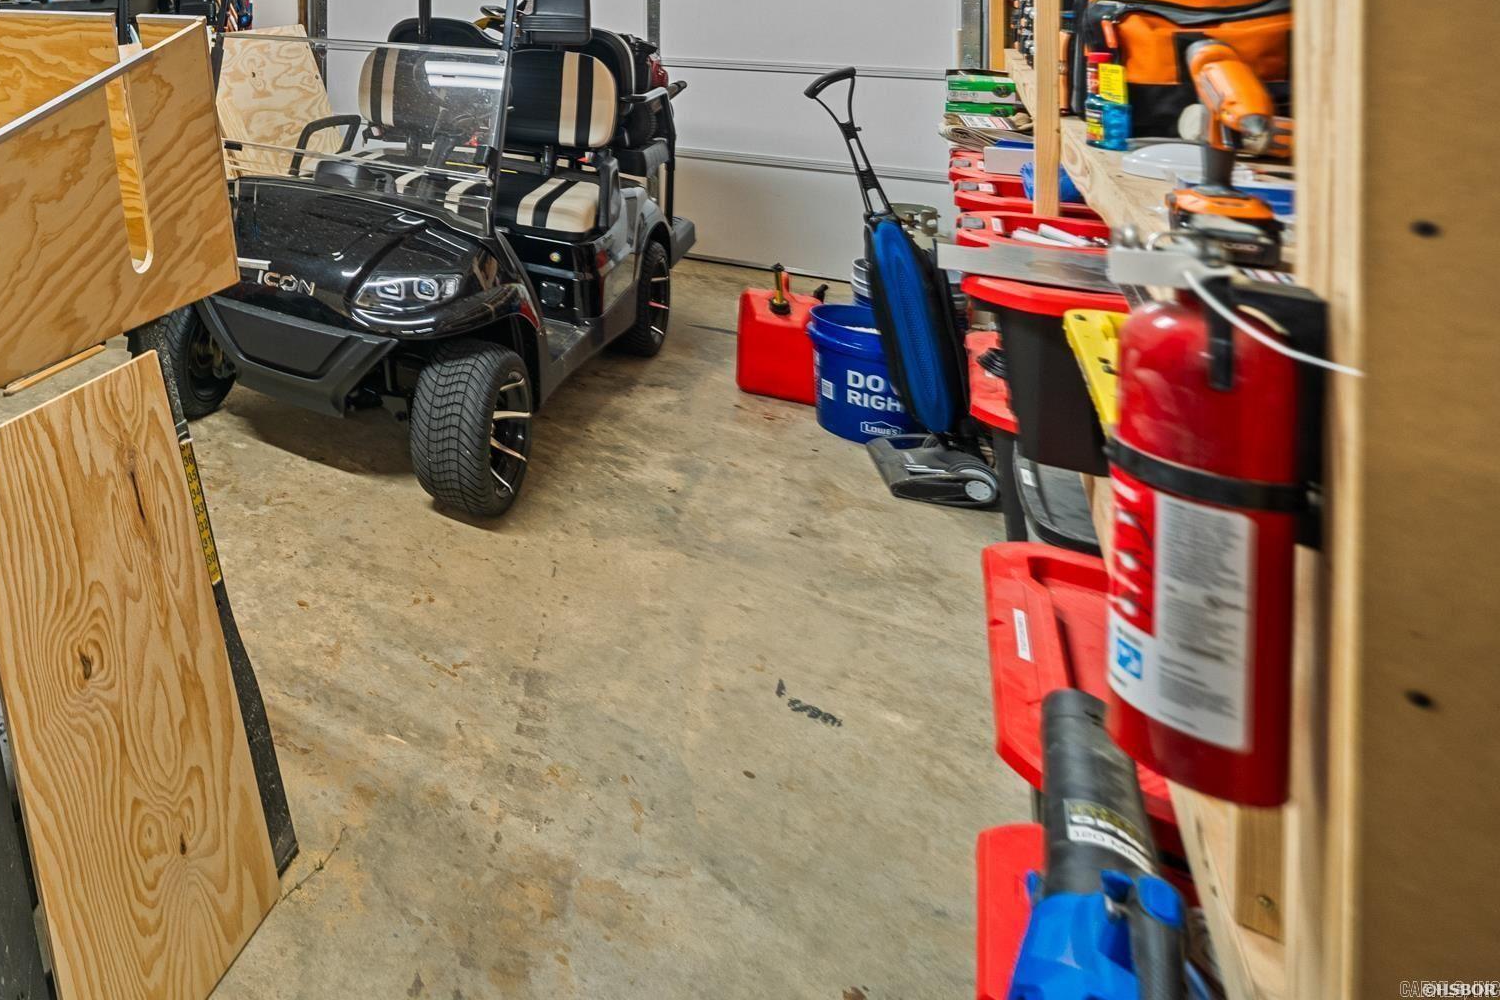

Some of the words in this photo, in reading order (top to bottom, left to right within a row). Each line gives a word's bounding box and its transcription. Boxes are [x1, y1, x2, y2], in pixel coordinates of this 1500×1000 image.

[257, 269, 316, 296] ICON
[846, 369, 885, 393] DO
[846, 389, 905, 413] RIGH
[184, 455, 194, 467] 36
[188, 471, 197, 483] 35
[192, 486, 200, 500] 34
[196, 502, 204, 515] 33
[200, 519, 208, 532] 32
[203, 535, 212, 549] 31
[207, 551, 215, 565] 30
